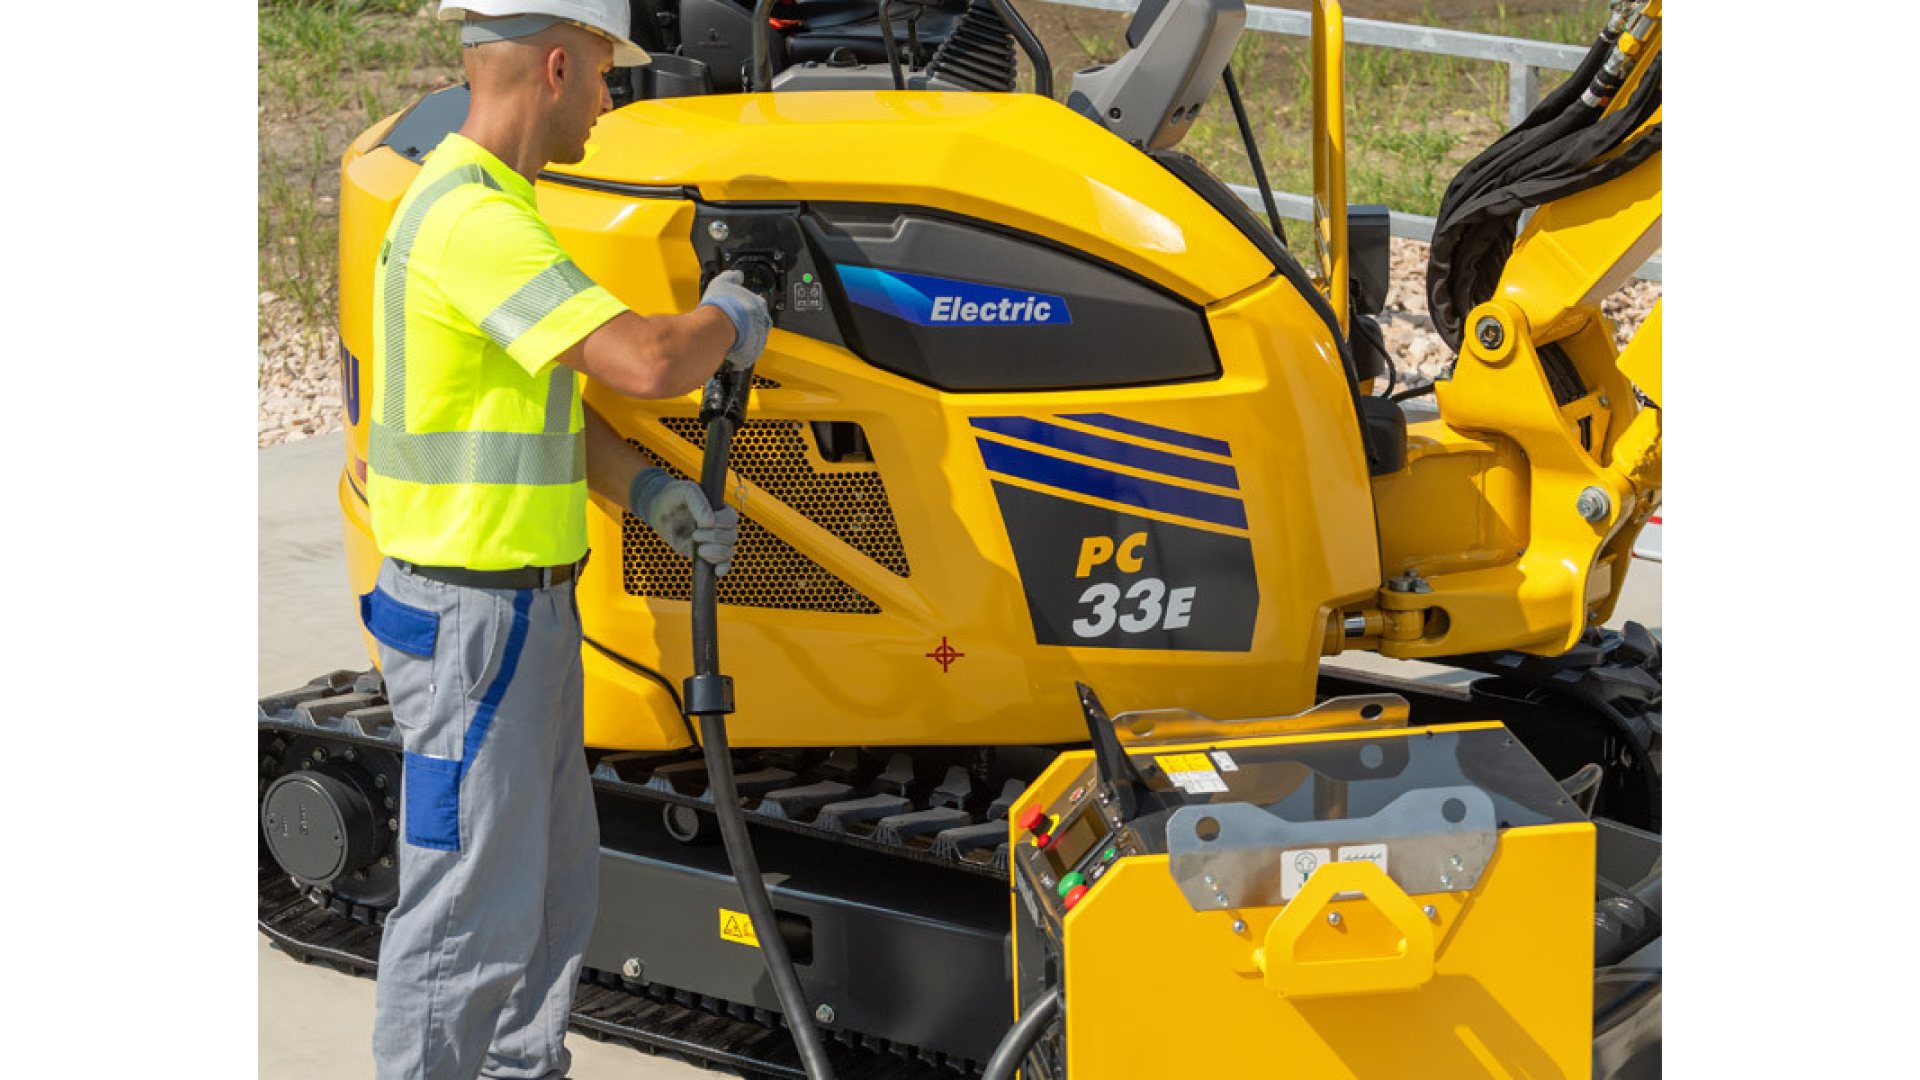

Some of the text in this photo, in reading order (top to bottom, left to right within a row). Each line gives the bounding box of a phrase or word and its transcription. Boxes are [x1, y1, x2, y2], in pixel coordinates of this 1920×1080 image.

[930, 296, 1052, 322] Electric
[1075, 531, 1148, 578] PC
[1072, 577, 1197, 638] 33E
